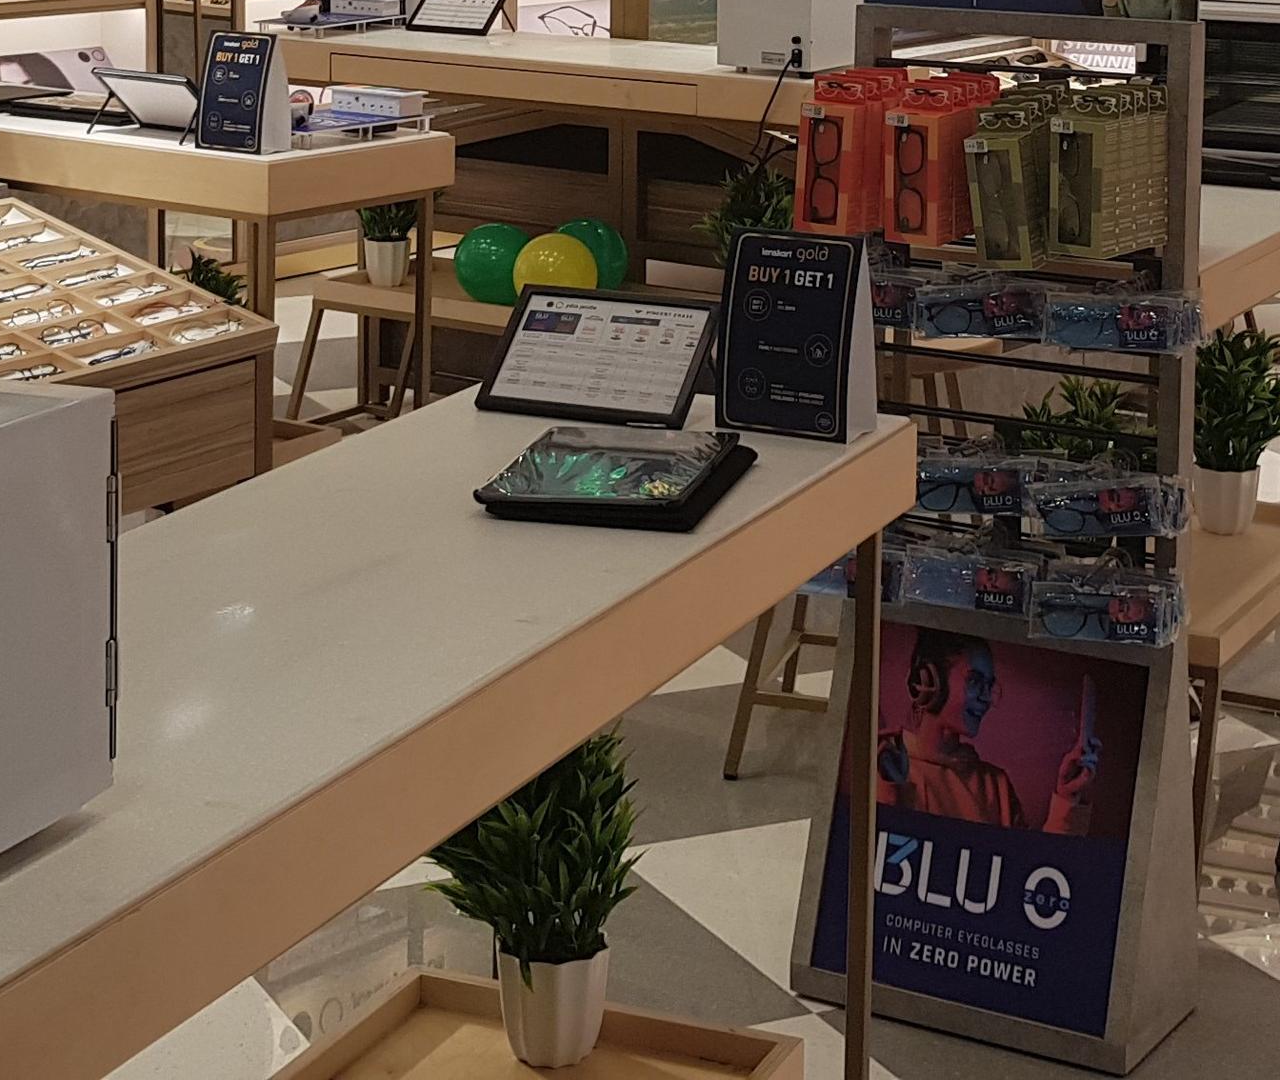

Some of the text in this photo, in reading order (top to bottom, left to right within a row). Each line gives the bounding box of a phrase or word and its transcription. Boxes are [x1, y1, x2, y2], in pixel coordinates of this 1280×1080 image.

[216, 51, 233, 62] BUY
[239, 53, 254, 64] GET
[762, 245, 829, 262] lenskart gold
[748, 265, 834, 289] BUY 1 GET 1
[874, 830, 1003, 915] BLU
[886, 913, 1040, 960] COMPUTER EYEGLASSES
[883, 935, 1038, 988] IN ZERO POWER
